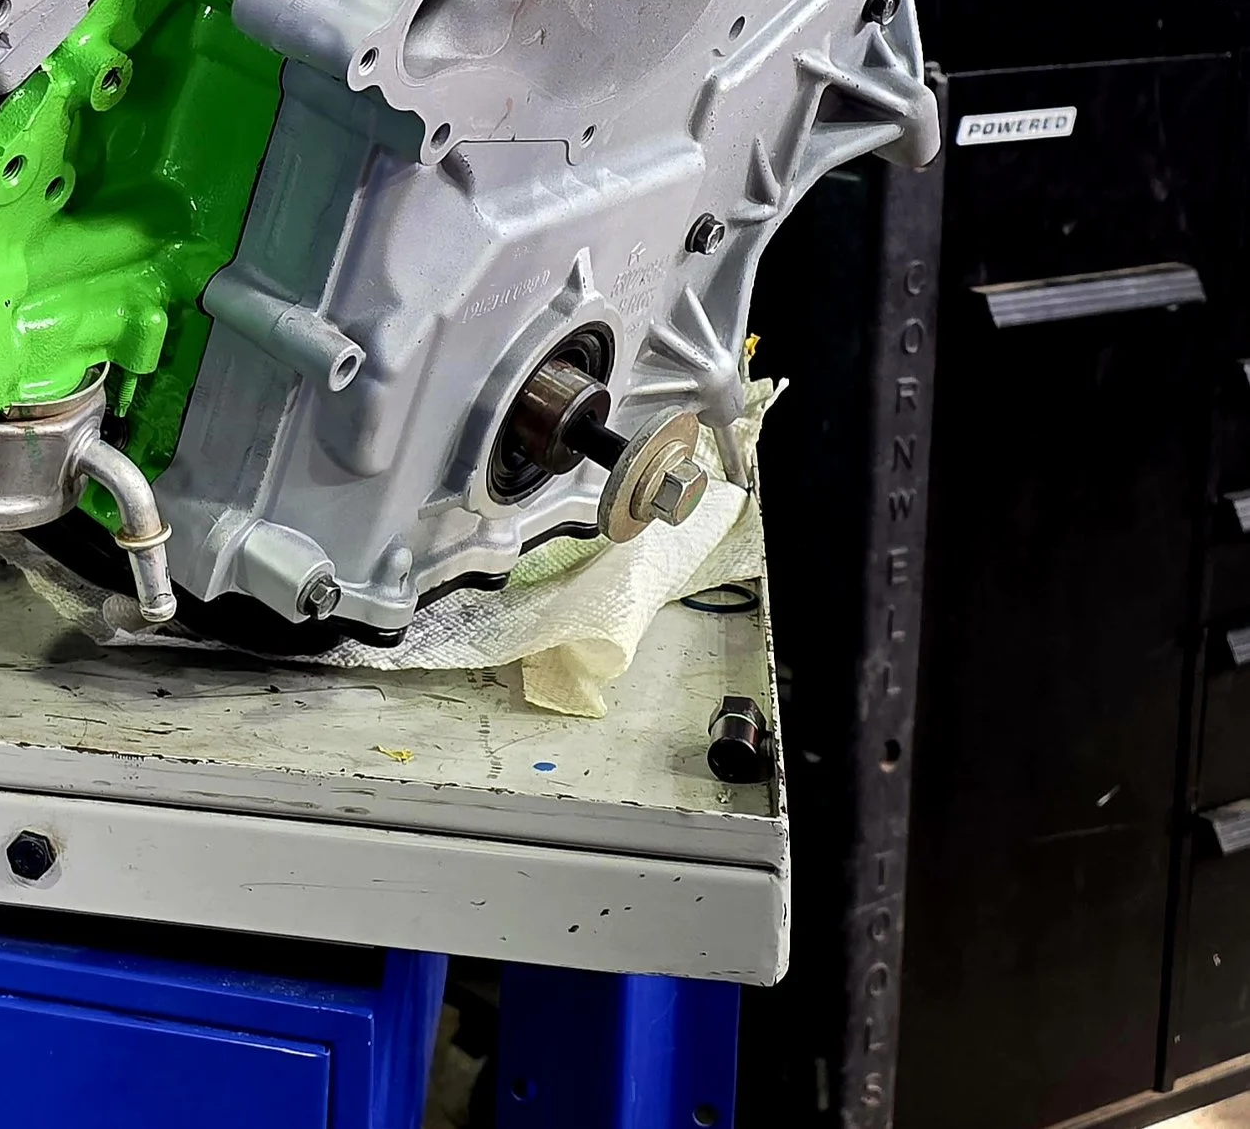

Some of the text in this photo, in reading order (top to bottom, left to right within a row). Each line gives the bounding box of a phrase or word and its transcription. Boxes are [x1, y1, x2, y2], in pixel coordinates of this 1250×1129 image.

[967, 115, 1069, 137] POWERED
[859, 258, 926, 1108] CORNWELL TOOLS
